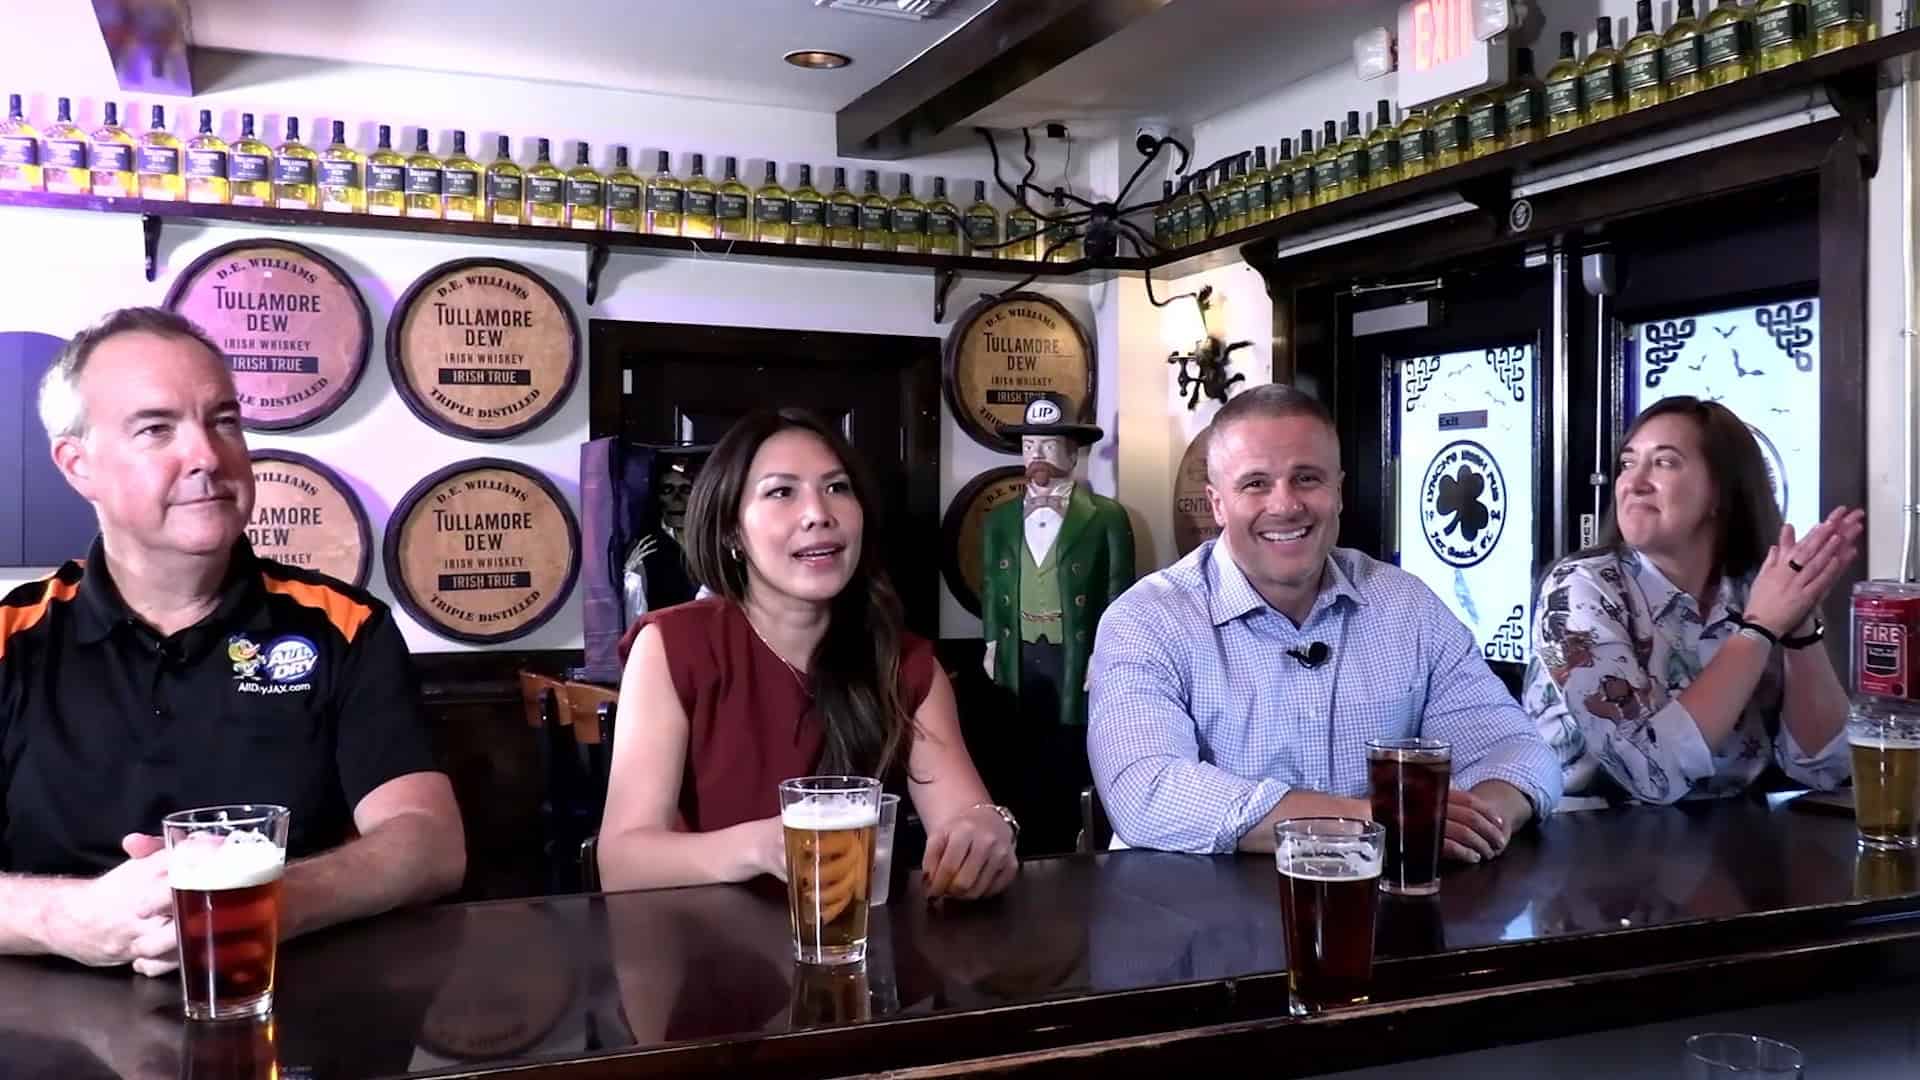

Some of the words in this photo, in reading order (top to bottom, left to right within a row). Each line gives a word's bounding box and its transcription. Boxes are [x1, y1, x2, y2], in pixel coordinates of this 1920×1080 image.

[216, 262, 246, 281] D.E.
[249, 258, 317, 284] WILLIAMS
[437, 280, 463, 297] D.E.
[466, 275, 530, 300] WILLIAMS
[213, 286, 321, 313] TULLAMORE
[247, 314, 288, 332] DEW
[434, 303, 533, 328] TULLAMORE
[224, 338, 255, 349] IRISH
[260, 339, 311, 351] WHISKEY
[465, 329, 503, 347] DEW
[983, 332, 1059, 353] TULLAMORE
[232, 357, 267, 369] IRISH
[271, 358, 303, 371] TRUE
[445, 353, 473, 364] IRISH
[478, 354, 524, 365] WHISKEY
[1007, 356, 1037, 371] DEW
[452, 370, 484, 382] IRISH
[487, 371, 517, 383] TRUE
[260, 377, 328, 407] DISTILLED
[997, 391, 1022, 403] IRISH
[430, 388, 474, 417] TRIPLE
[478, 388, 541, 418] DISTILLED
[1032, 407, 1053, 418] LIP
[436, 486, 462, 505] D.E.
[464, 479, 529, 502] WILLIAMS
[249, 507, 322, 525] AMORE
[433, 509, 533, 532] TULLAMORE
[248, 528, 289, 546] DEW
[1583, 516, 1591, 546] PUS
[465, 533, 503, 551] DEW
[444, 559, 473, 569] IRISH
[477, 557, 524, 568] WHISKEY
[452, 575, 484, 588] IRISH
[487, 574, 517, 587] TRUE
[429, 593, 474, 622] TRIPLE
[479, 590, 541, 622] DISTILLED
[1863, 625, 1900, 643] FIRE
[272, 655, 318, 680] DRY
